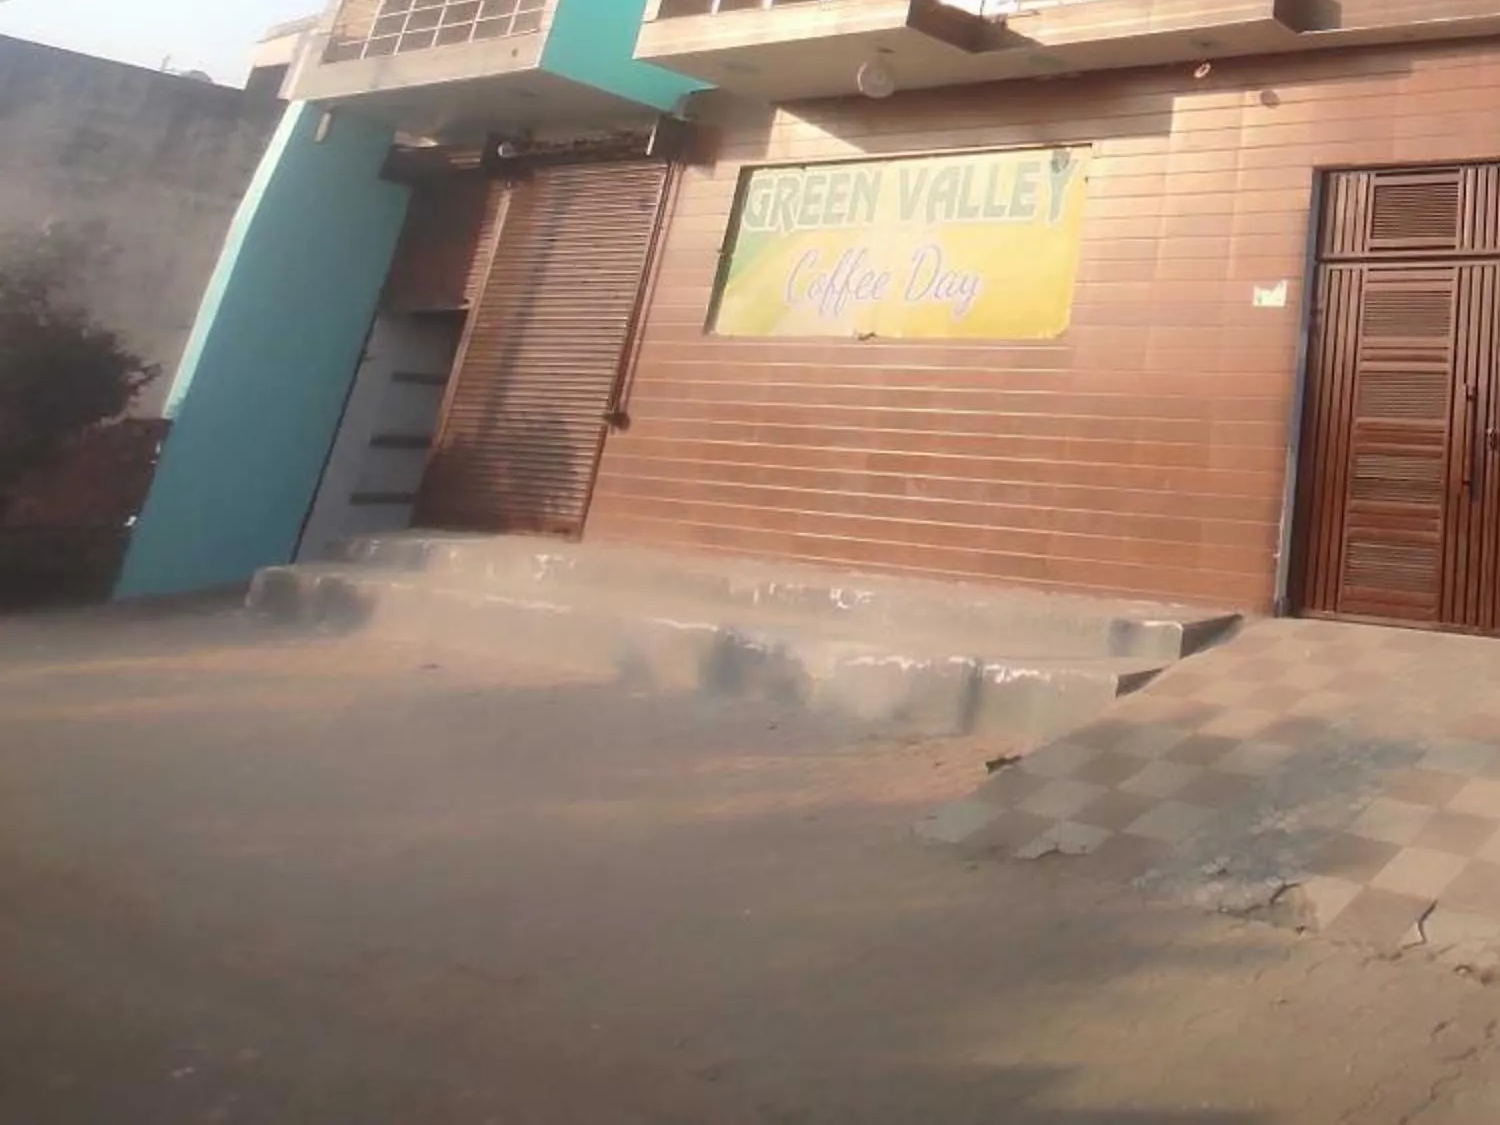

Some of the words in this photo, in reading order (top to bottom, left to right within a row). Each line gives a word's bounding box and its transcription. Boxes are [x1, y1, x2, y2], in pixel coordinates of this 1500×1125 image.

[744, 169, 883, 231] GREEN
[900, 159, 1080, 222] VALLEY
[786, 247, 891, 317] Coffee
[904, 244, 981, 321] Day
